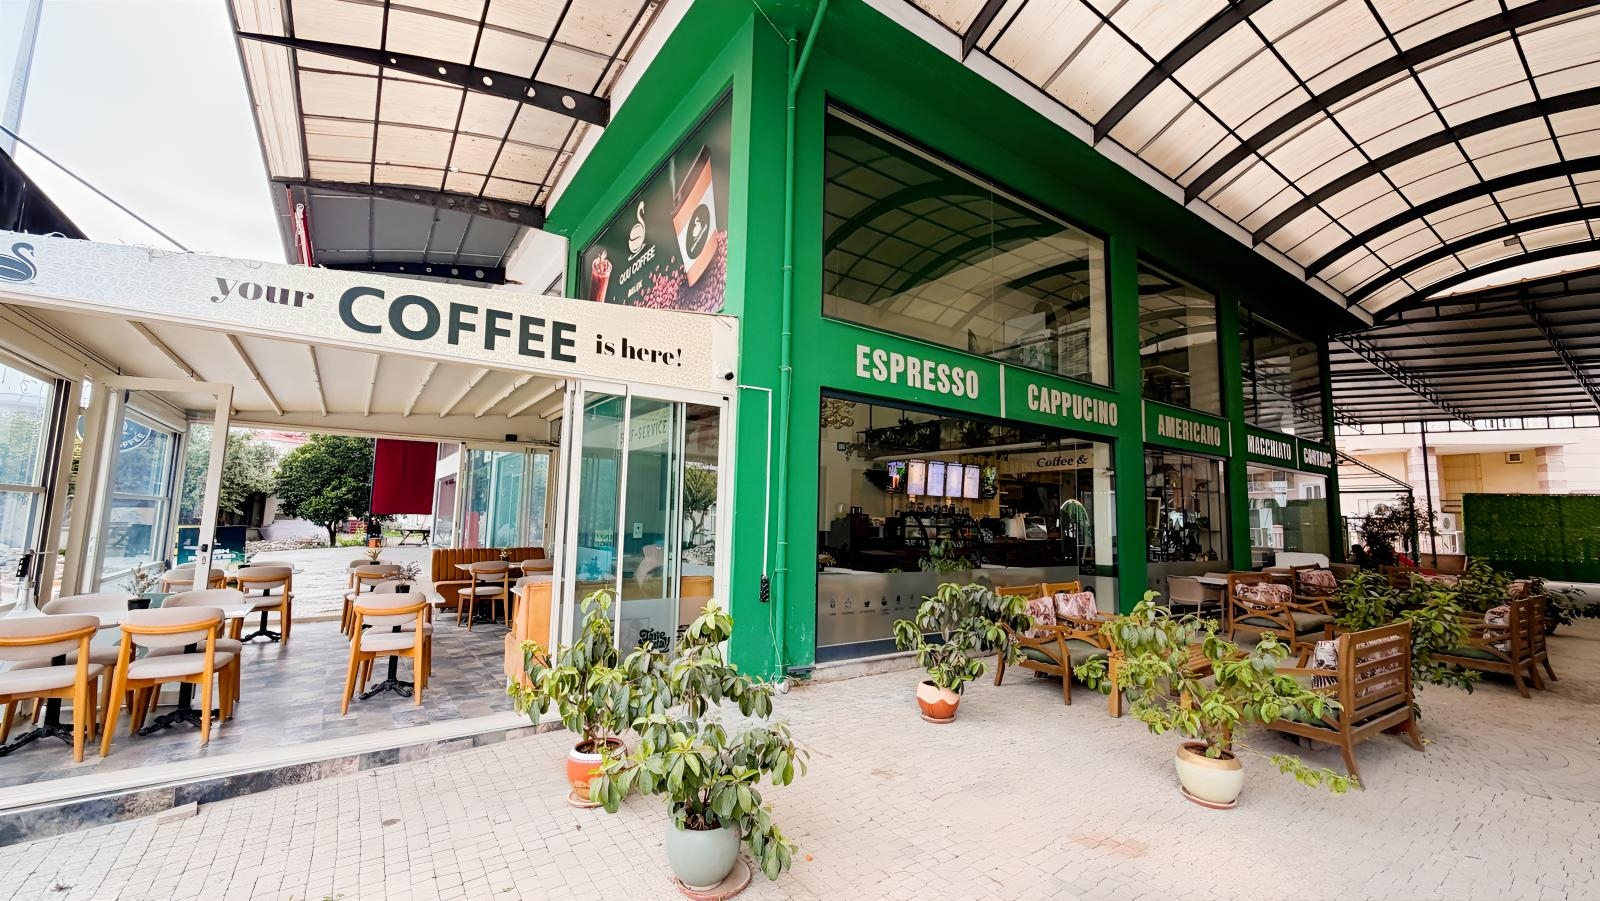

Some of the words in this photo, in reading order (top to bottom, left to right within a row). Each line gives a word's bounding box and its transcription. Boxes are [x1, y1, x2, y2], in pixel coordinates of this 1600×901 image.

[632, 245, 656, 274] COFFEE
[210, 277, 315, 308] your
[338, 286, 577, 364] COFFEE
[595, 334, 616, 356] is
[621, 337, 682, 367] here!
[856, 343, 979, 400] ESPRESSO
[1027, 383, 1118, 427] CAPPUCINO
[1157, 414, 1221, 447] AMERICANO
[1036, 456, 1074, 468] Coffee
[1076, 454, 1089, 466] &
[1247, 434, 1292, 461] MACCHIATO
